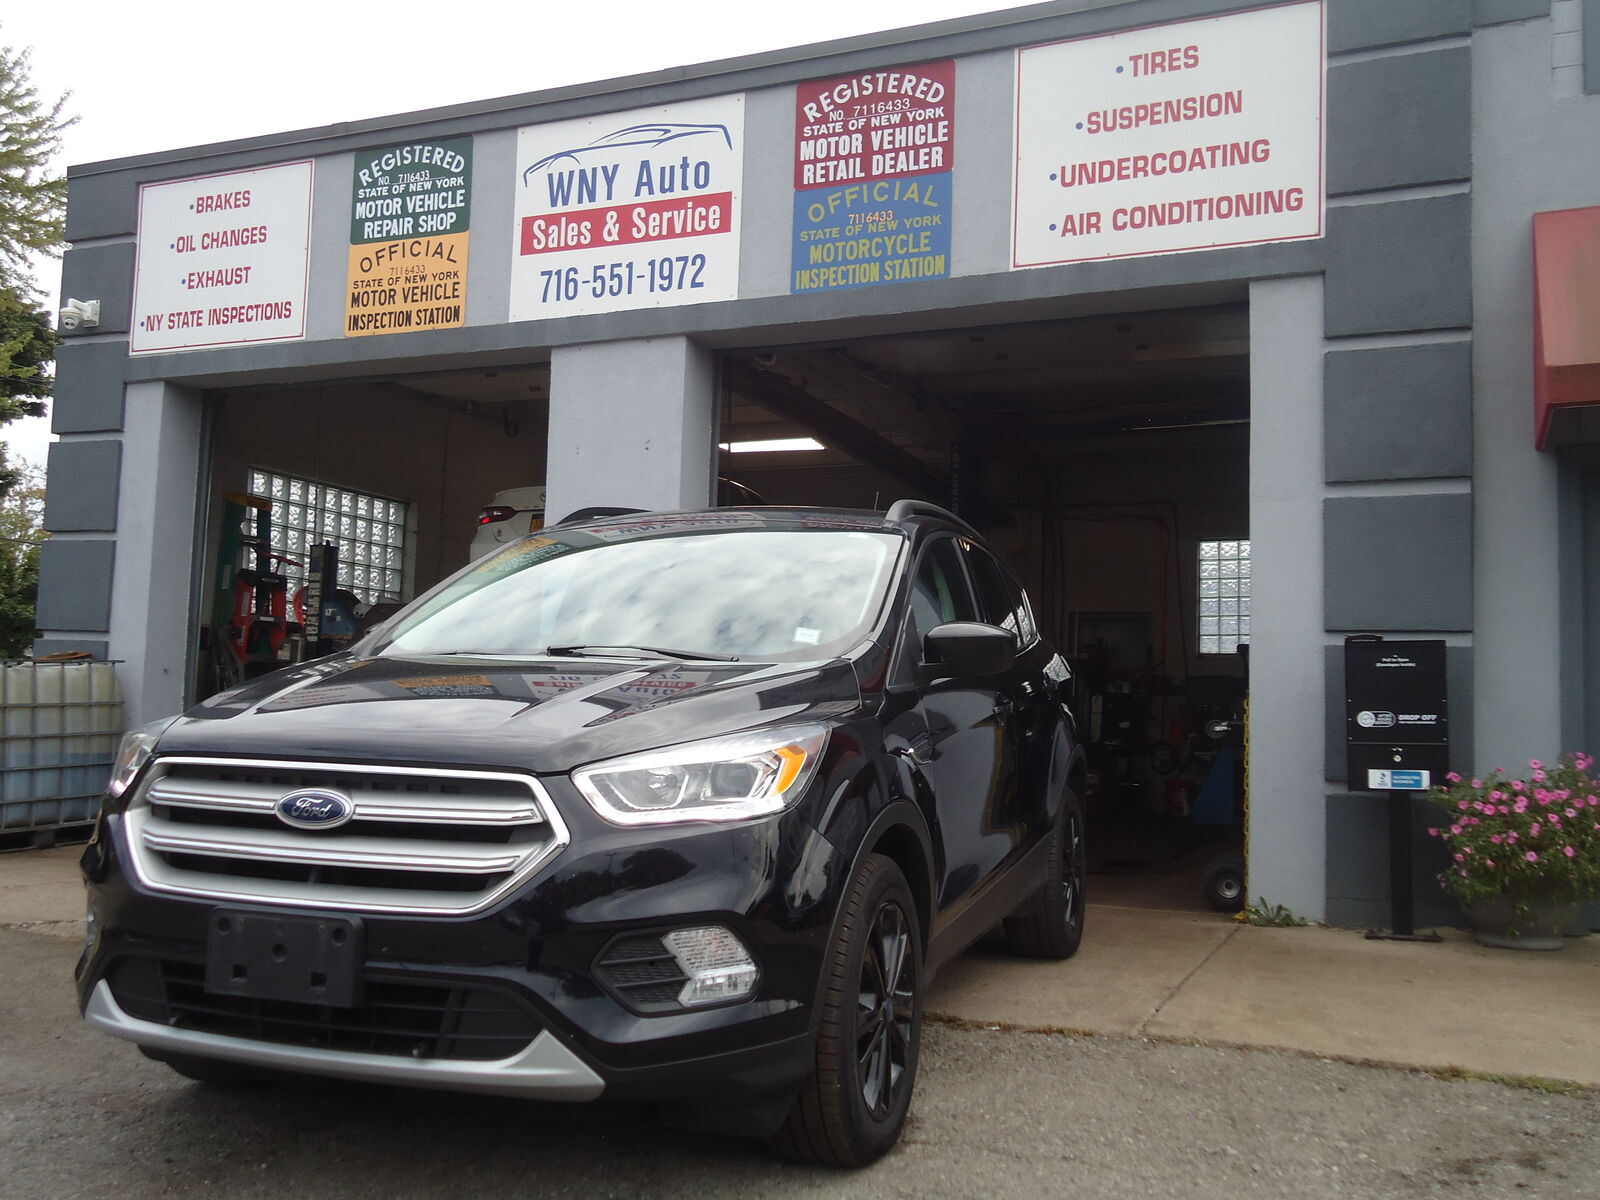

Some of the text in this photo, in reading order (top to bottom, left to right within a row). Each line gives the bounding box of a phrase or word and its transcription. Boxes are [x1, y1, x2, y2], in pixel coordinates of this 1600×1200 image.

[1129, 46, 1199, 77] TIRES
[803, 73, 944, 123] REGISTERED
[854, 98, 910, 117] 7116433
[1087, 90, 1242, 134] SUSPENSION
[804, 107, 944, 136] STATE OF NEW YORK
[800, 121, 948, 161] MOTOR VEHICLE
[359, 146, 465, 186] REGISTERED
[398, 170, 430, 183] 7116433
[803, 147, 943, 184] RETAIL DEALER
[1061, 139, 1270, 188] UNDERCOATING
[358, 176, 464, 198] STATE OF NEW YORK
[548, 156, 710, 208] WNY Auto
[196, 190, 251, 214] BRAKES
[356, 189, 466, 219] MOTOR VEHICLE
[808, 181, 938, 222] OFFICIAL
[1061, 188, 1303, 237] AIR CONDITIONING
[364, 212, 456, 239] REPAIR SHOP
[533, 201, 721, 250] Sales & Service
[800, 215, 942, 241] STATE OF NEW YORK
[848, 210, 893, 224] 7116433
[176, 225, 267, 253] OIL CHANGES
[810, 231, 931, 265] MOTORCYCLE
[360, 240, 457, 273] OFFICIAL
[390, 265, 425, 276] 7116433
[187, 267, 251, 290] EXHAUST
[353, 270, 459, 289] STATE OF NEW YORK
[540, 254, 706, 303] 716-551-1972
[796, 255, 944, 290] INSPECTION STATION
[351, 282, 460, 308] MOTOR VEHICLE
[146, 301, 292, 332] NY STATE INSPECTIONS
[348, 305, 460, 331] INSPECTION STATION
[291, 798, 332, 818] Ford
